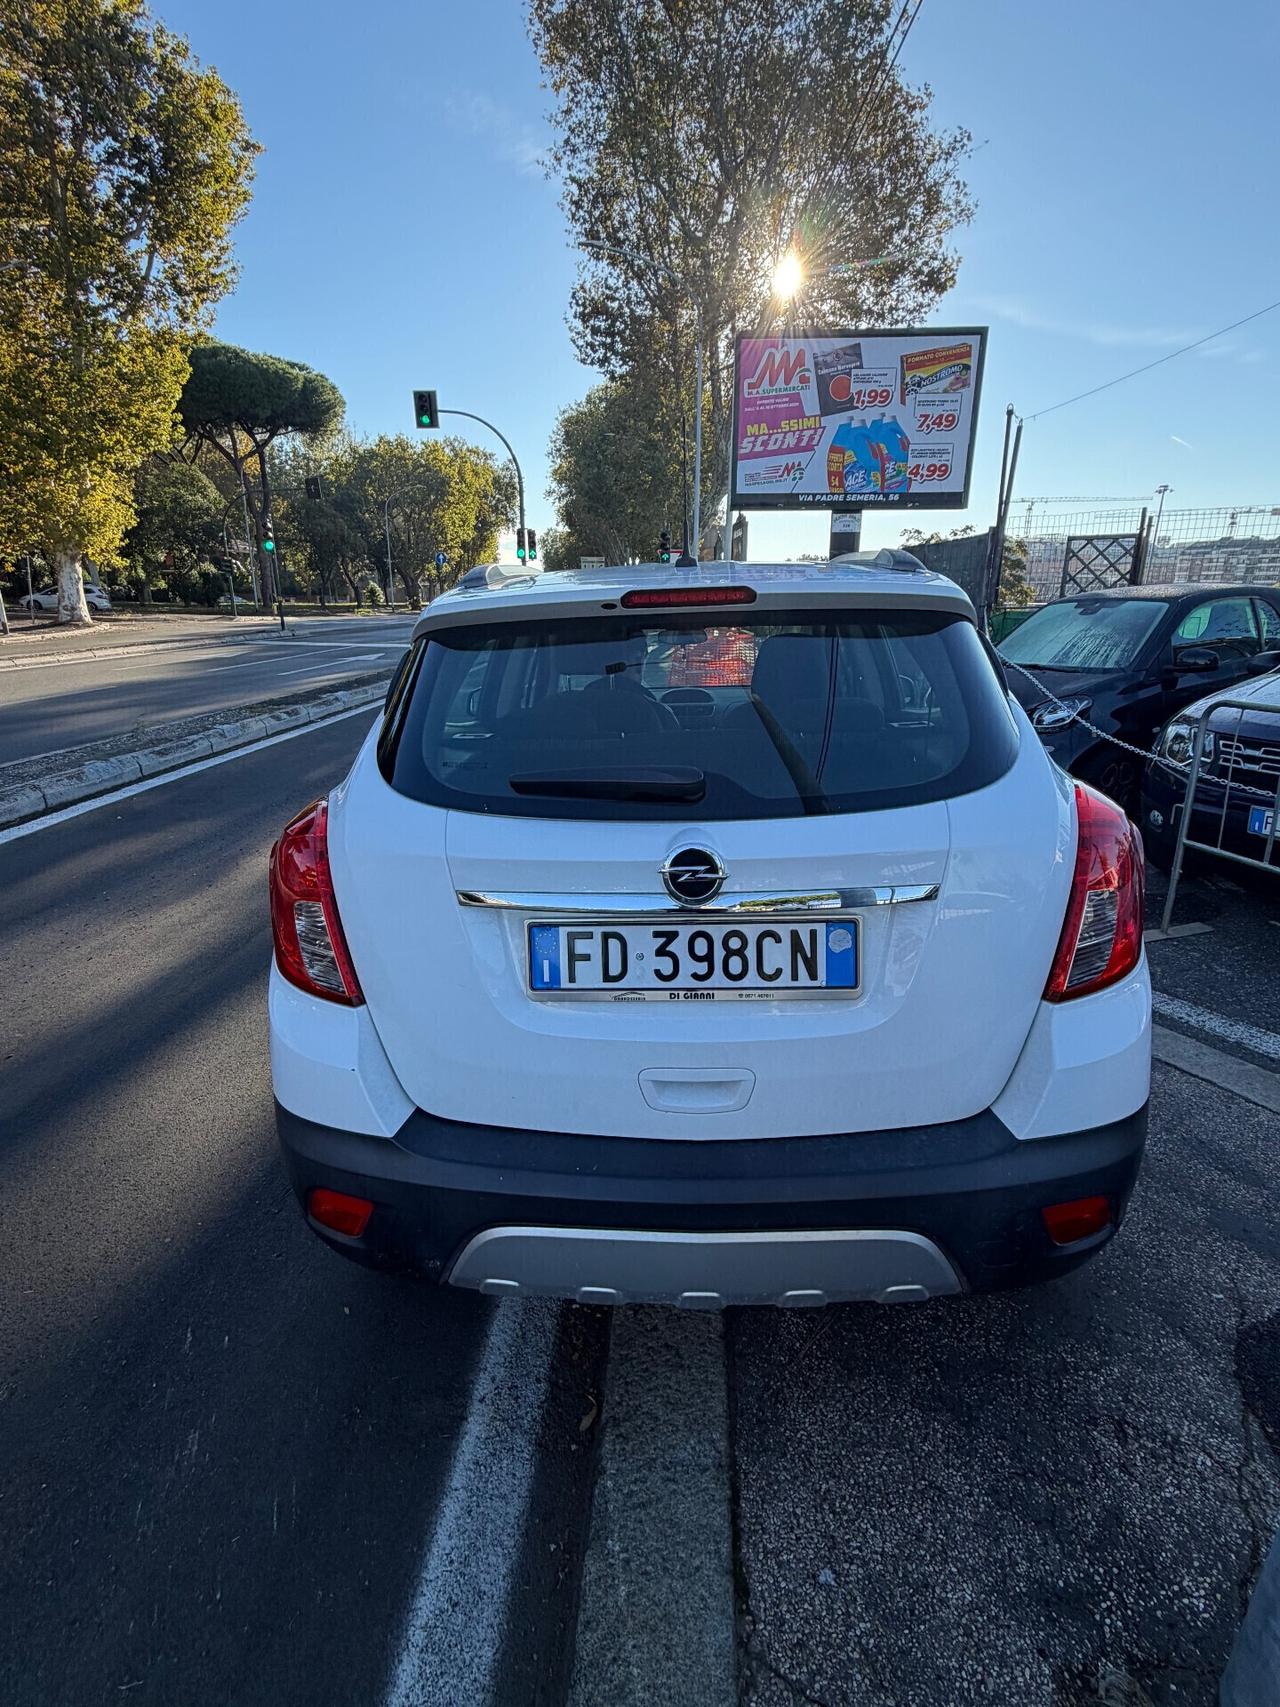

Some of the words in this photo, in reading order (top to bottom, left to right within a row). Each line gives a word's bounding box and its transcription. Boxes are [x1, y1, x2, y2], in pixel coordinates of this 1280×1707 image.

[906, 353, 934, 363] FORMATO
[920, 364, 964, 387] NOSTROMO
[853, 388, 892, 408] 1,99
[917, 412, 957, 431] 7,49
[739, 428, 823, 454] SCONTI
[845, 470, 866, 487] ACE
[908, 462, 950, 481] 4,99
[798, 494, 813, 502] VIA
[814, 494, 844, 502] PADRE
[845, 493, 886, 502] SEMERIA,
[566, 930, 628, 984] FD
[651, 928, 819, 983] 398CN
[669, 992, 680, 1001] DI
[683, 992, 715, 1001] GIANNI
